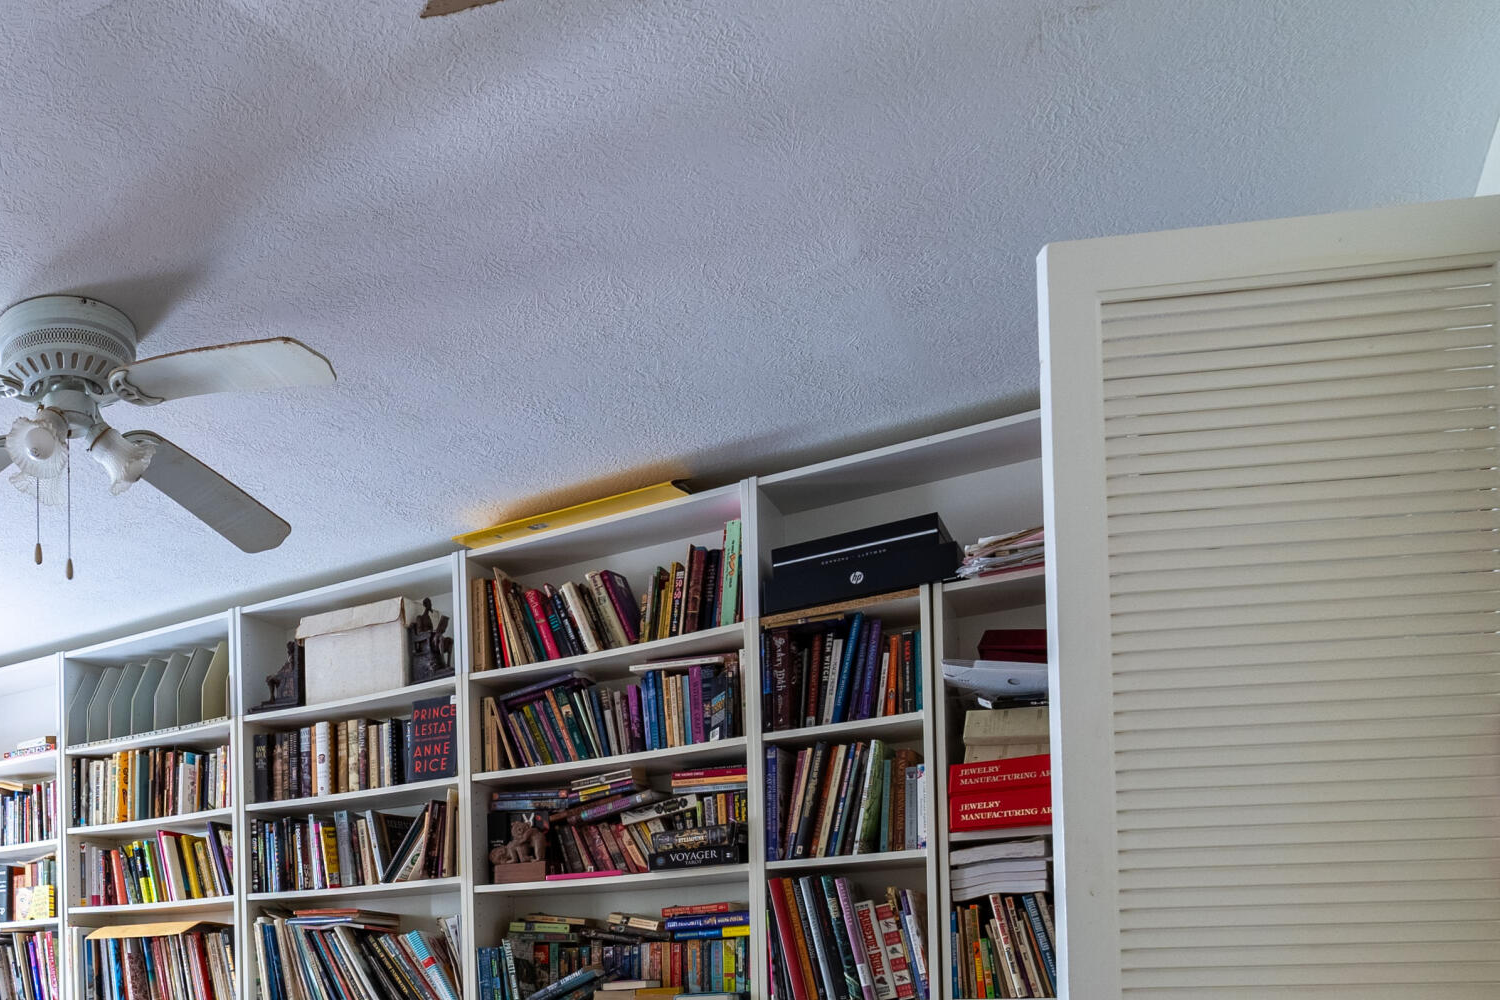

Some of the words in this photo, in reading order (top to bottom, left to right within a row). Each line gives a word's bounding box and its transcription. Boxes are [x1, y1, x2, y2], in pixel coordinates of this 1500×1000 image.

[850, 571, 864, 585] hp
[822, 656, 831, 681] WITCH
[413, 704, 457, 721] PRINCE
[414, 720, 453, 737] LESTAT
[413, 742, 451, 759] ANNE
[414, 758, 448, 774] RICE
[959, 765, 1000, 777] JEWELRY
[960, 772, 1037, 786] MANUFACTURING
[960, 800, 1001, 811] JEWELRY
[961, 807, 1038, 822] MANUFACTURING
[670, 850, 718, 862] VOYAGER
